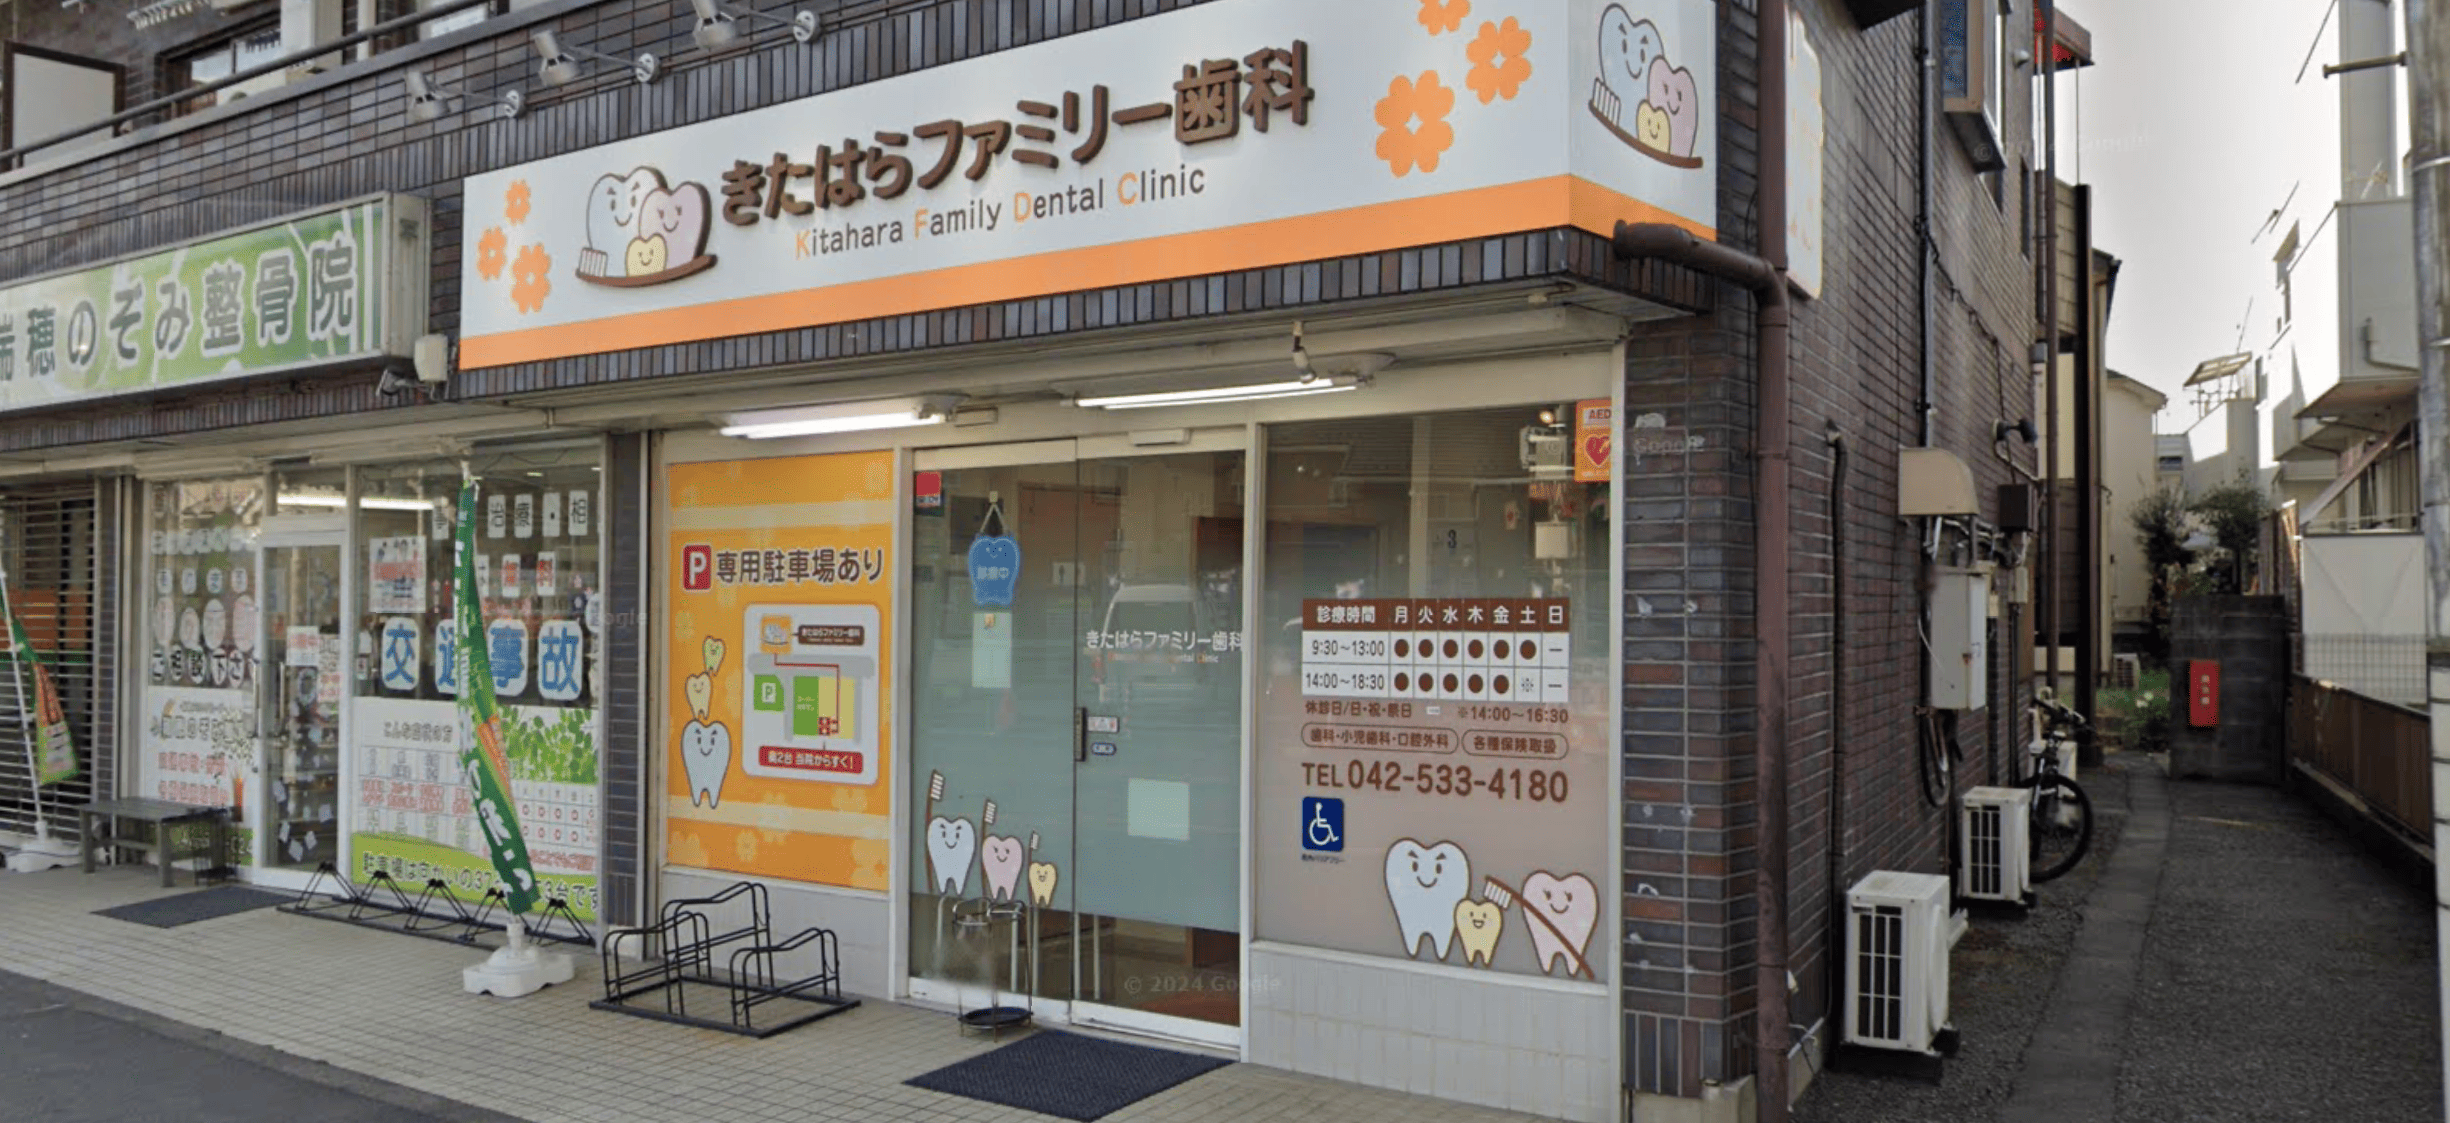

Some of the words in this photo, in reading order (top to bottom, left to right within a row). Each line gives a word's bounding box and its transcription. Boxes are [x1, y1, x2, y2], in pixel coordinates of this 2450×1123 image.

[721, 39, 1314, 226] きたはらファミリー歯科
[795, 216, 904, 260] Kitahara
[913, 197, 1002, 242] Family
[1012, 177, 1105, 224] Dental
[1116, 163, 1206, 206] Clinic
[1588, 409, 1611, 419] AED
[689, 552, 707, 586] P
[716, 548, 883, 583] 専用駐車場あり
[1317, 606, 1375, 624] 診療時間
[1394, 606, 1408, 623] 月
[1418, 606, 1433, 623] 火
[1443, 606, 1458, 623] 水
[1468, 607, 1484, 624] 木
[1494, 607, 1509, 624] 金
[1520, 607, 1536, 624] 土
[1549, 607, 1563, 624] 日
[1086, 630, 1242, 651] きたはらファミリー歯科
[1302, 762, 1344, 787] TEL
[1348, 759, 1569, 802] 042-533-4180
